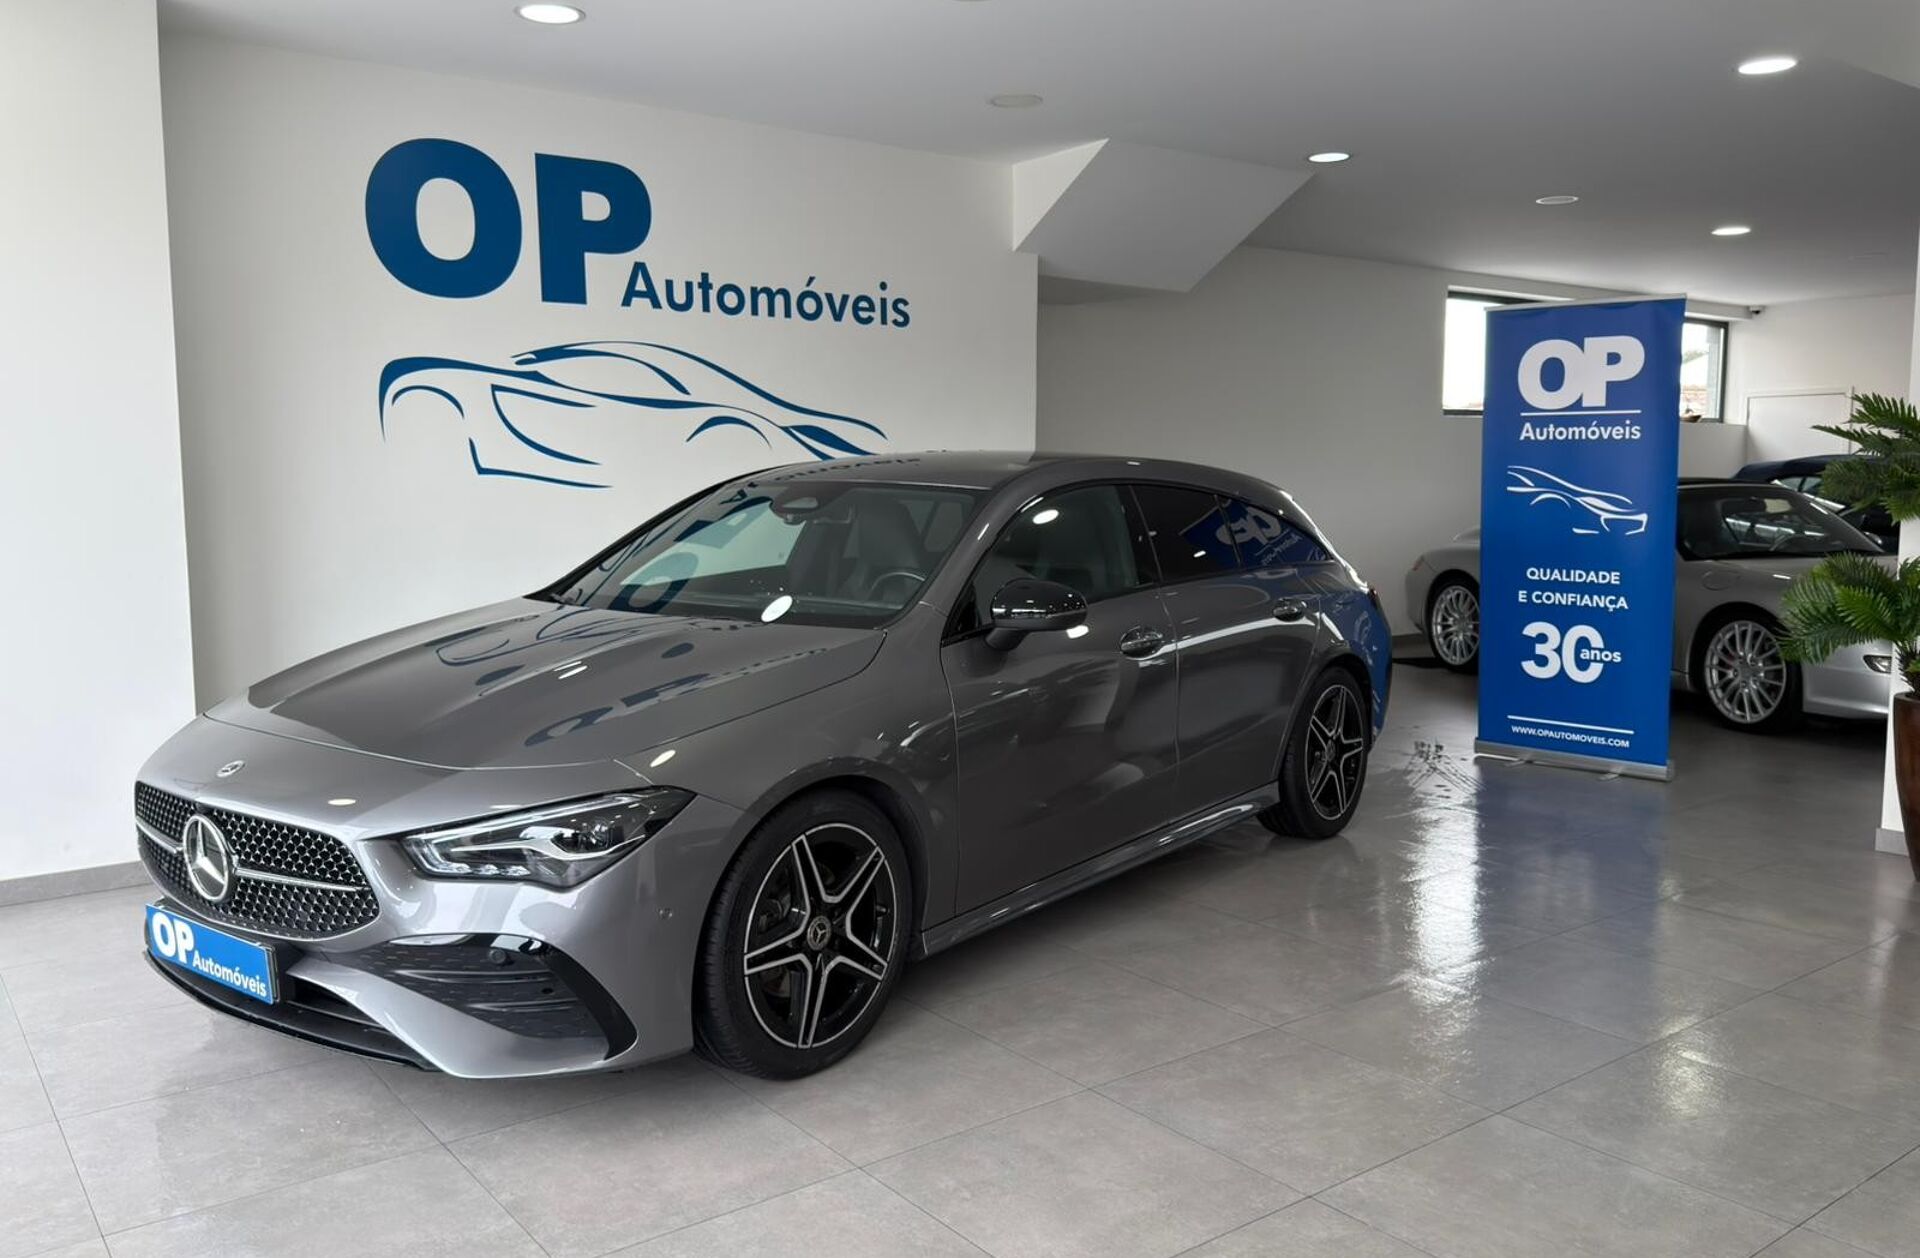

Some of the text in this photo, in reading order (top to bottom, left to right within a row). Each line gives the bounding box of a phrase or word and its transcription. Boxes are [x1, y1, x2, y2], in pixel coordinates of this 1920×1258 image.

[365, 138, 911, 328] OP Automóveis
[1518, 335, 1645, 410] OP
[1519, 419, 1641, 441] Automóveis
[1526, 567, 1621, 585] QUALIDADE
[1518, 590, 1629, 612] E CONFIANÇA
[1521, 621, 1622, 684] 30 anos
[1511, 724, 1630, 748] WWW.OPAUTOMOVEIS.COM
[152, 912, 267, 997] OP Automóveis
